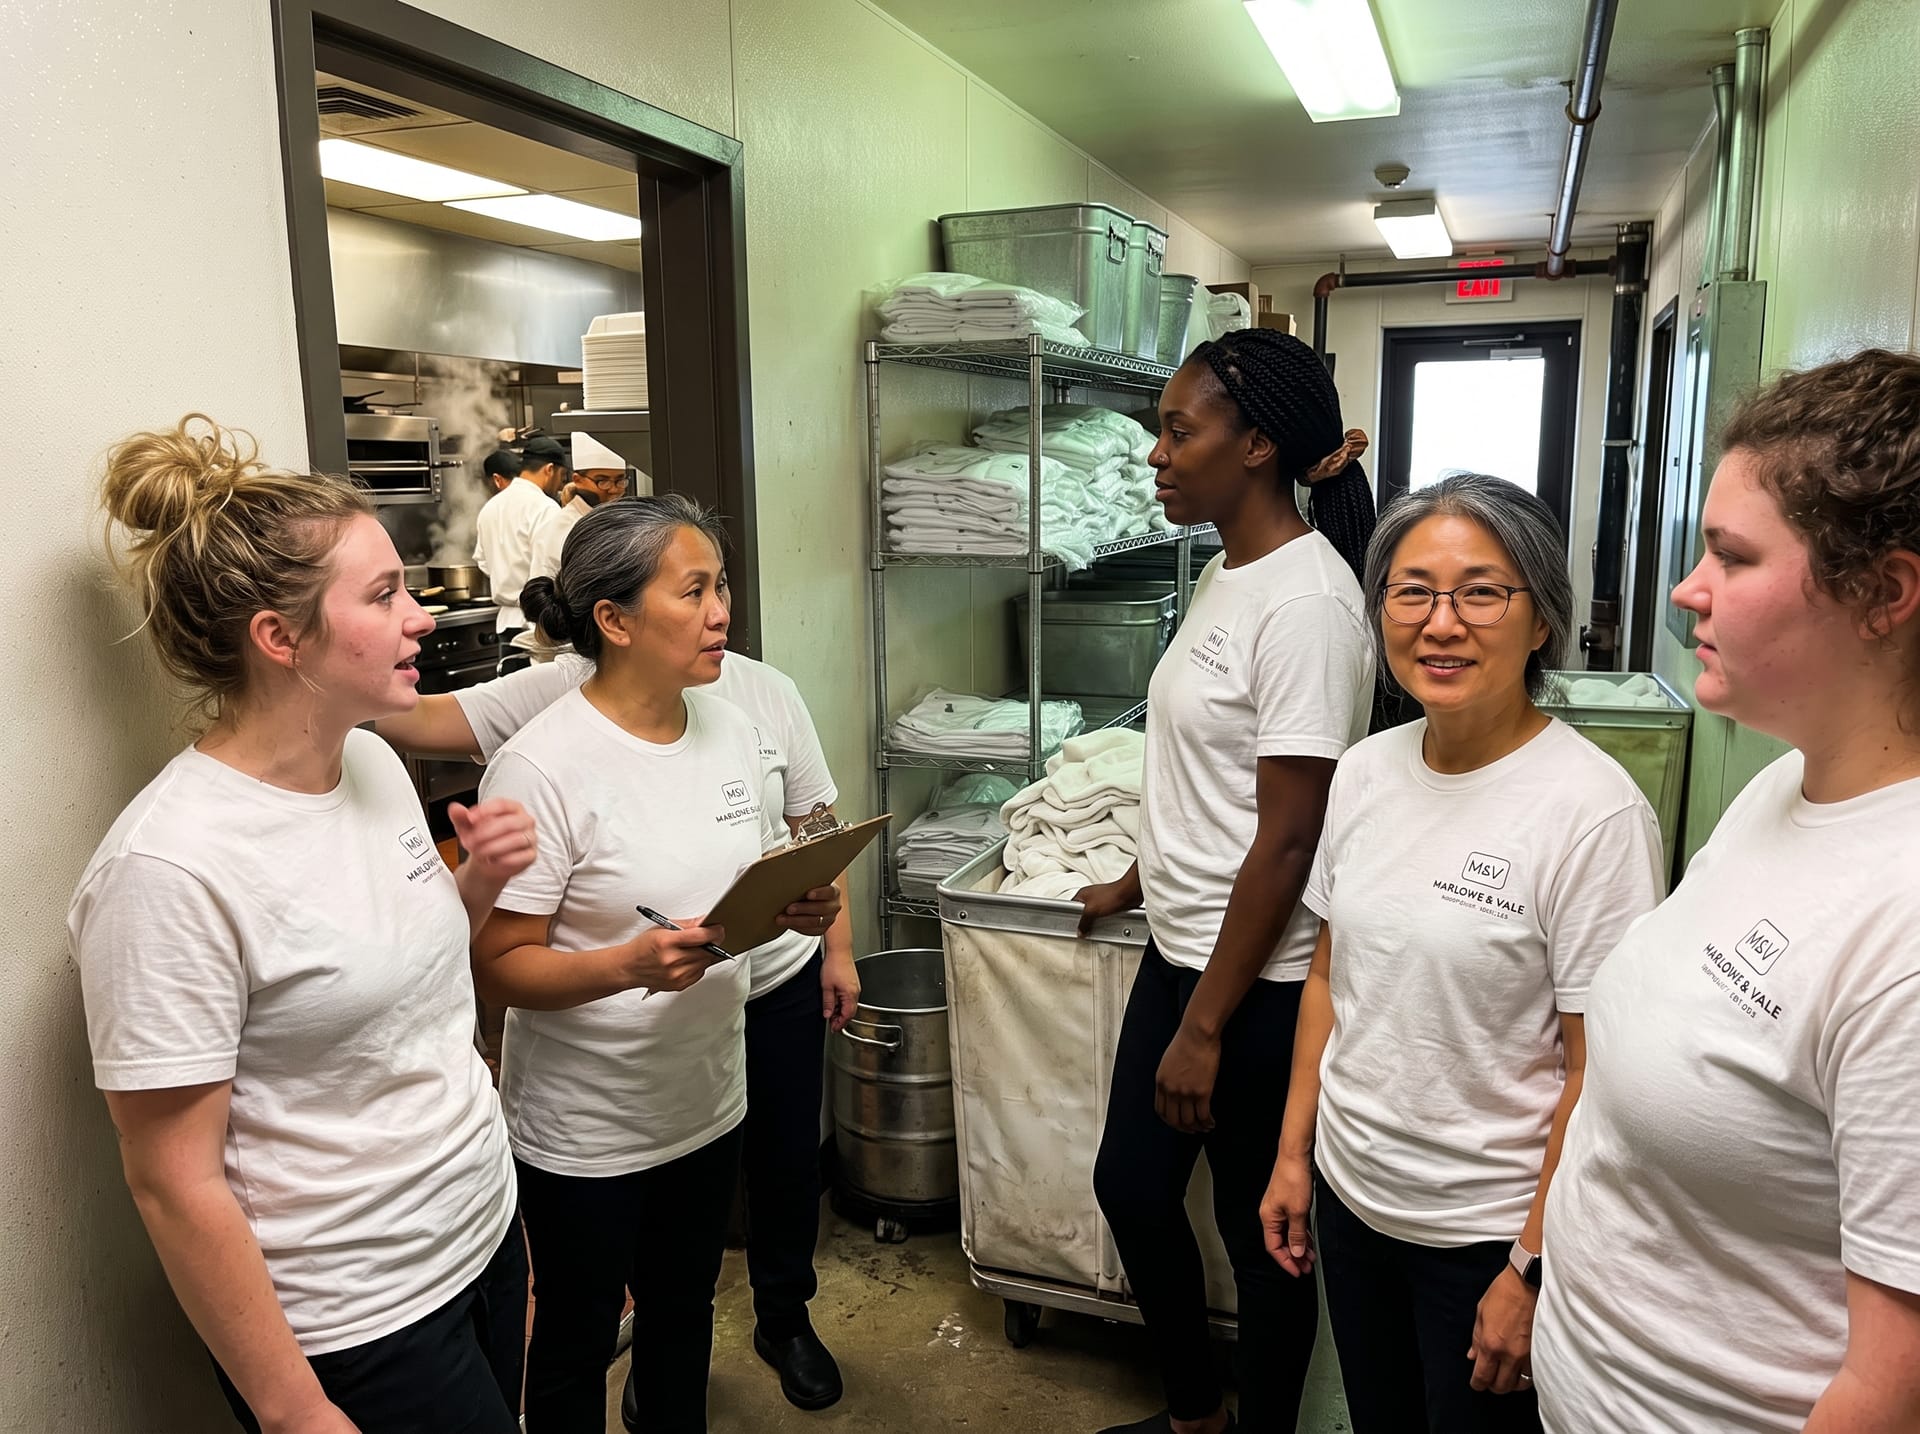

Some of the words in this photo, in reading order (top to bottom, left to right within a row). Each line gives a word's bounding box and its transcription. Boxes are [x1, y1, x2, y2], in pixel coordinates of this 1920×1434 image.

[1457, 259, 1504, 297] EXIT
[1433, 880, 1485, 902] MARLOWE
[1485, 895, 1493, 904] &
[1496, 898, 1525, 915] VALE
[1740, 980, 1750, 993] &
[1750, 986, 1782, 1020] VALE
